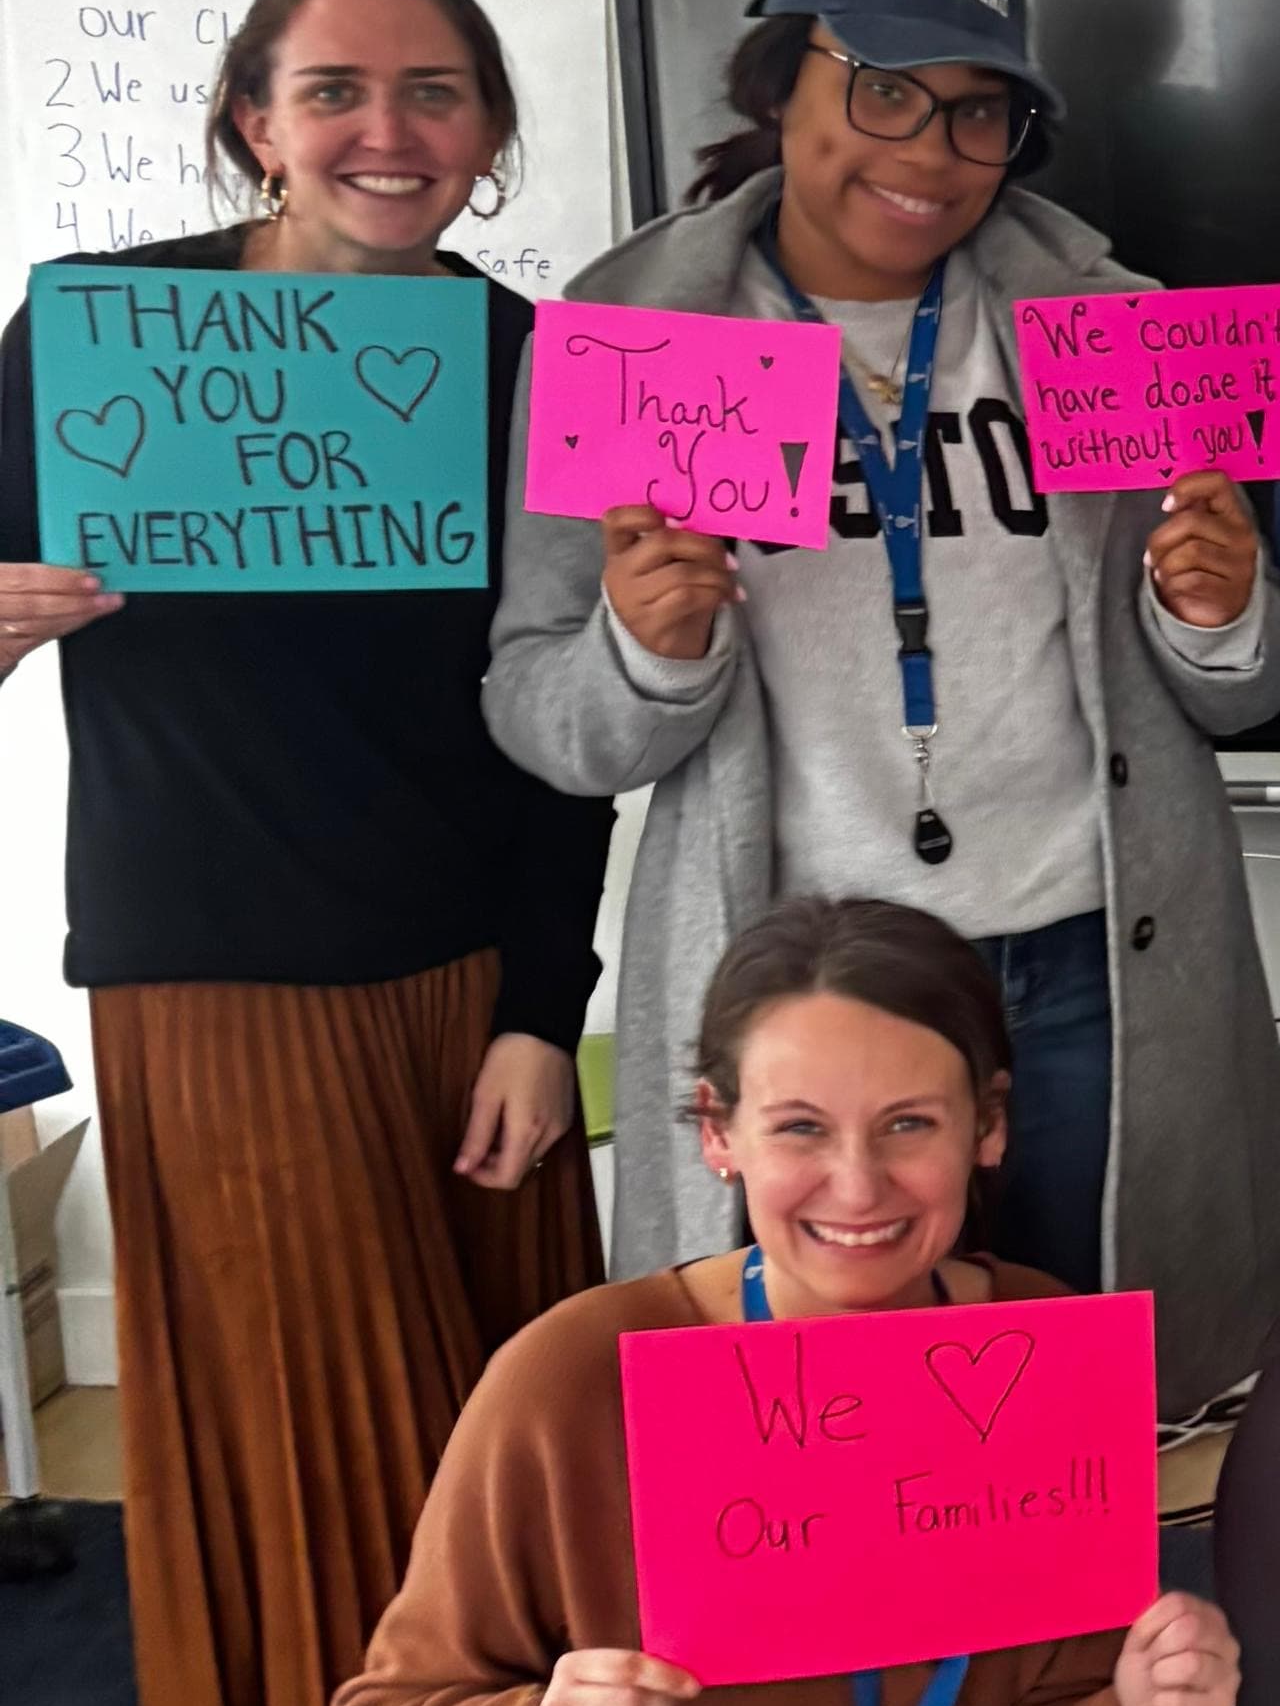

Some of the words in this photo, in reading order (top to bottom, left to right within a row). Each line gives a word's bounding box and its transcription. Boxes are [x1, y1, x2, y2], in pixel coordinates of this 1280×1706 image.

[79, 6, 157, 41] our
[45, 58, 75, 108] 2
[91, 61, 142, 103] We
[47, 123, 86, 187] 3
[102, 132, 153, 183] We
[56, 201, 82, 251] 4
[107, 207, 153, 250] We
[58, 283, 338, 353] THANK
[1022, 302, 1113, 358] We
[151, 365, 286, 424] YOU
[566, 334, 759, 435] Thank
[1036, 380, 1121, 422] have
[1145, 361, 1240, 409] done
[235, 431, 368, 490] FOR
[1040, 417, 1178, 469] without
[646, 430, 809, 521] You!
[79, 501, 475, 570] EVERYTHING
[733, 1333, 868, 1448] We
[716, 1497, 825, 1558] Our
